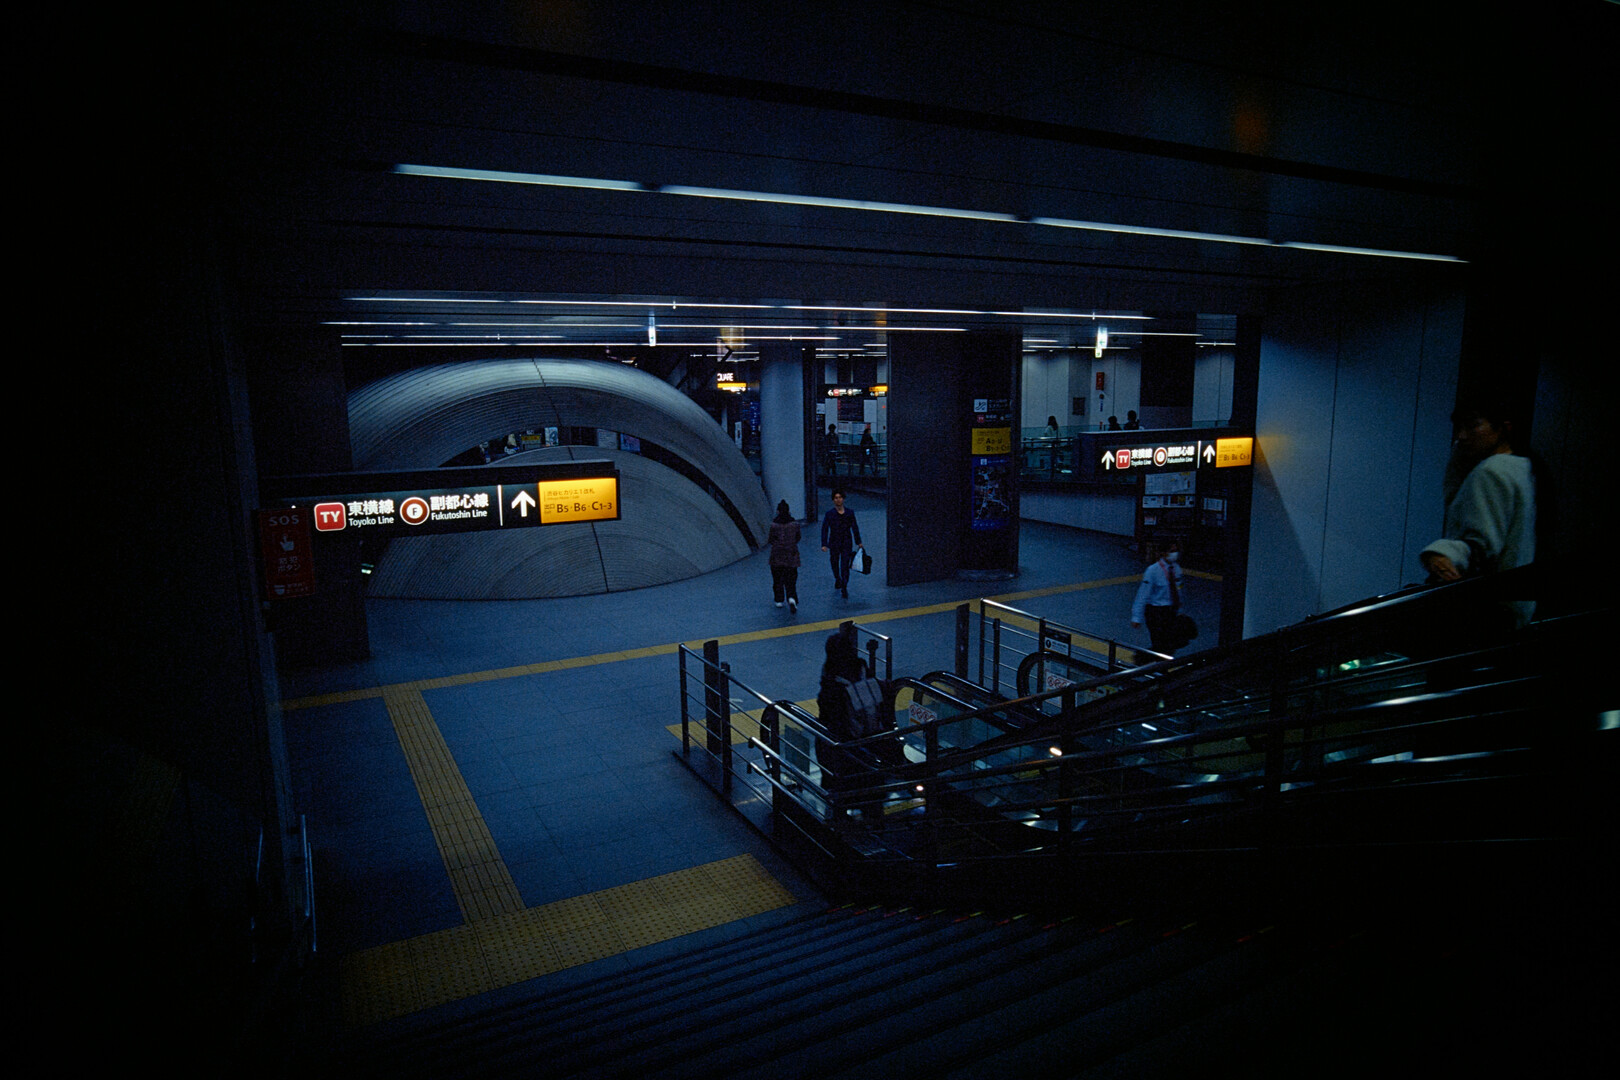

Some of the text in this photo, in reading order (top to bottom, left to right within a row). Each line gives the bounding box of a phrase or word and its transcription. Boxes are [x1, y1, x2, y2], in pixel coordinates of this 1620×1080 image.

[1119, 455, 1128, 464] TY
[347, 499, 395, 516] 東横線
[430, 493, 489, 511] 副都心線
[556, 501, 613, 513] B5 B6 C1-3
[268, 514, 300, 526] SOS
[320, 510, 341, 523] TY
[431, 509, 488, 521] Fukutoshin Line
[348, 515, 394, 528] Toyoko Line
